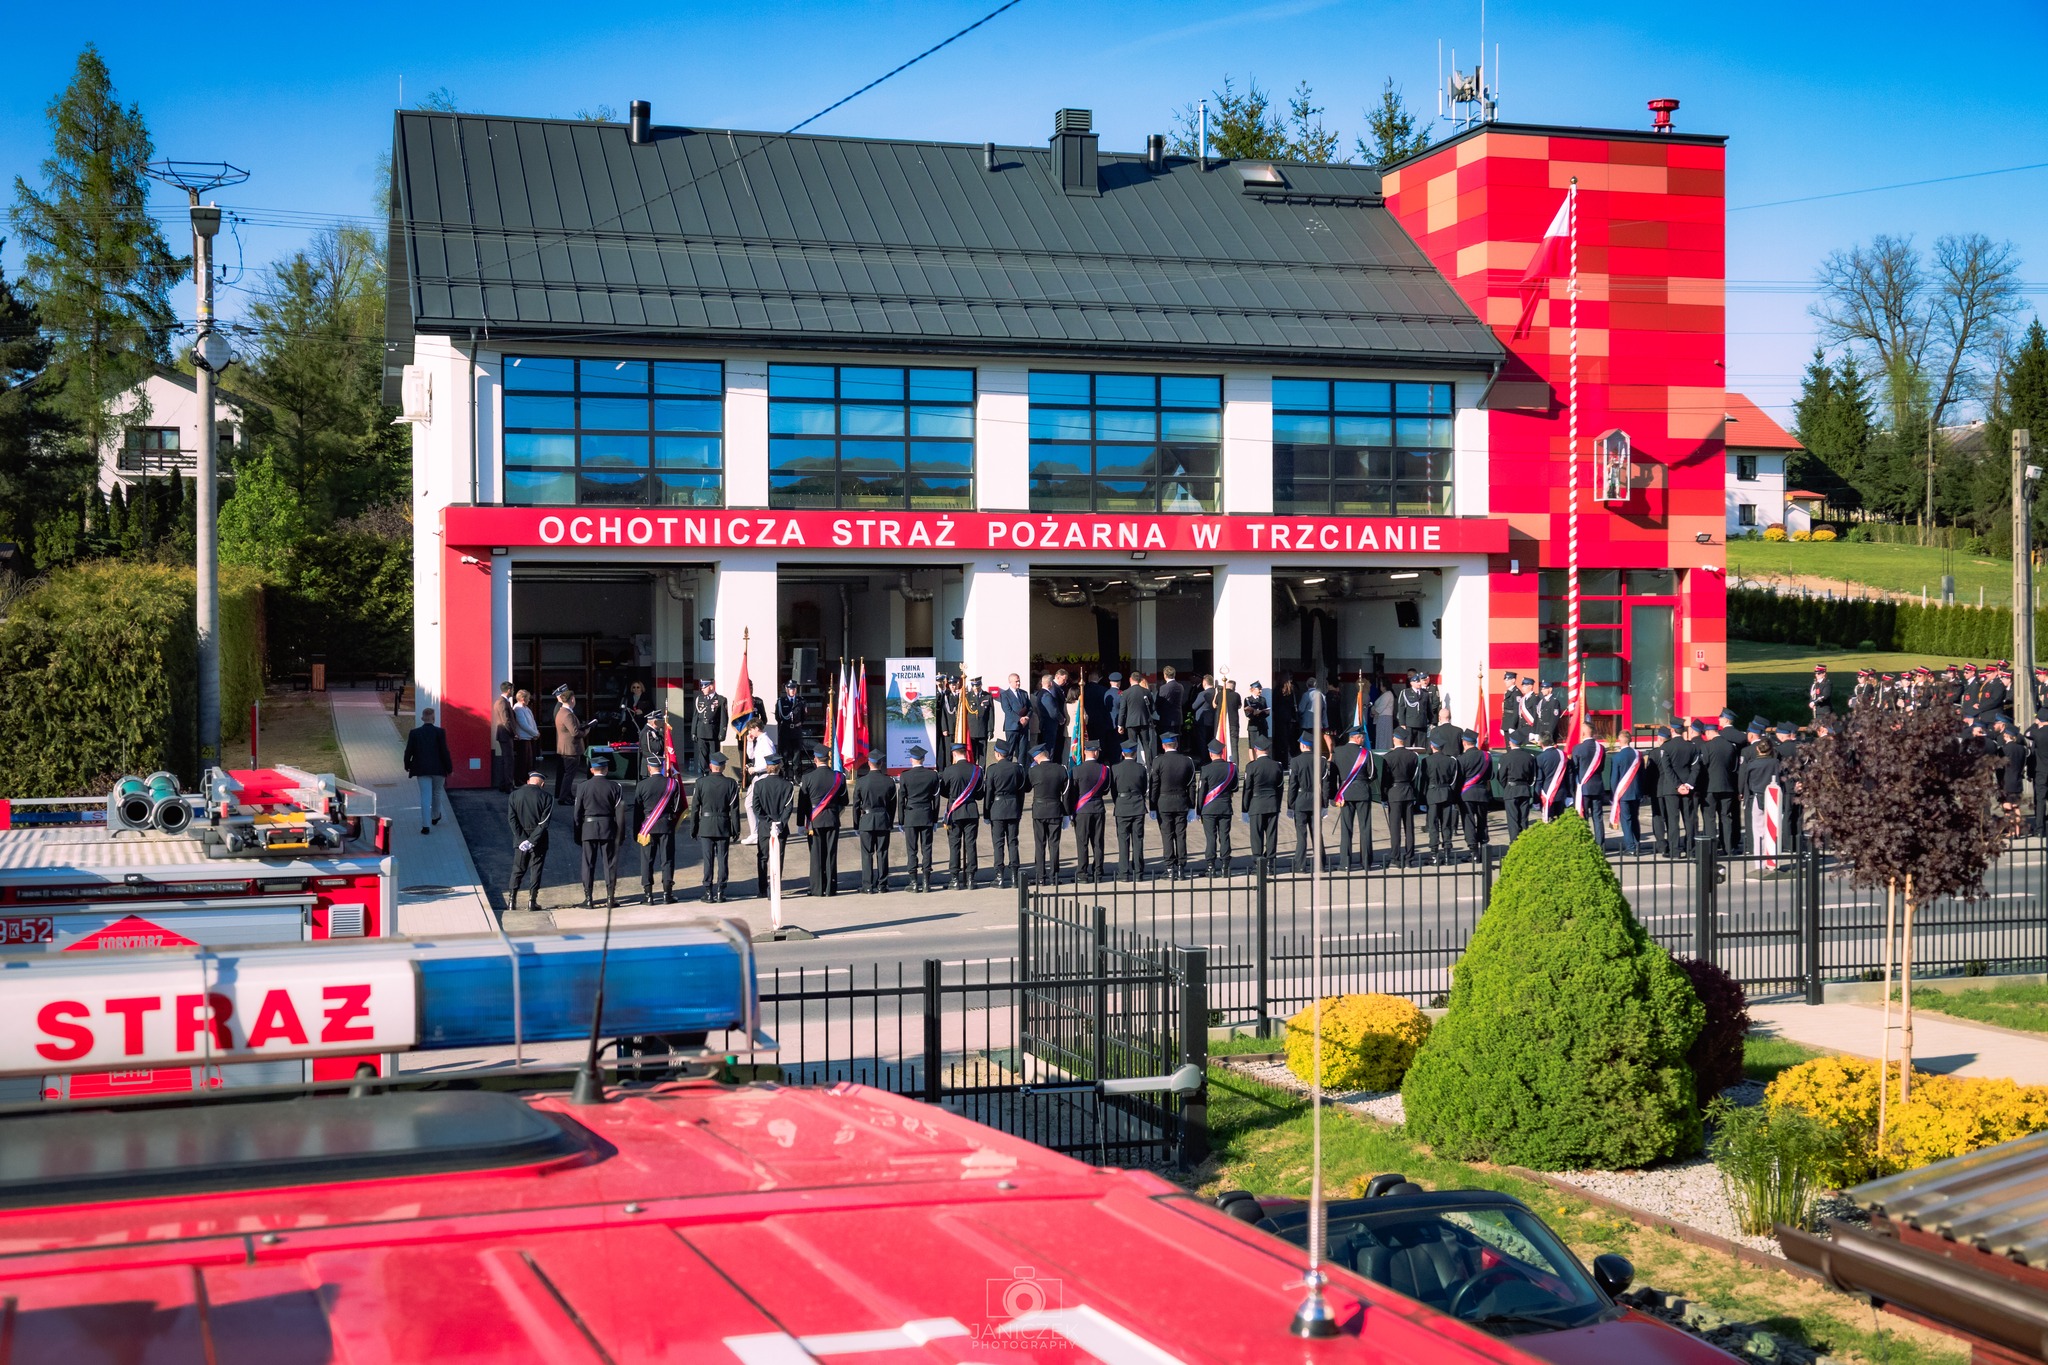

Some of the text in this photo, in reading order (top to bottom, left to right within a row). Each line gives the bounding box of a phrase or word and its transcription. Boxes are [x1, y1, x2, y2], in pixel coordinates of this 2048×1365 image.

[538, 514, 1441, 550] OCHOTNICZA STRAŻ POŻARNA W TRZCIANIE
[901, 664, 921, 672] GMINA
[897, 672, 925, 680] TRZCIANA
